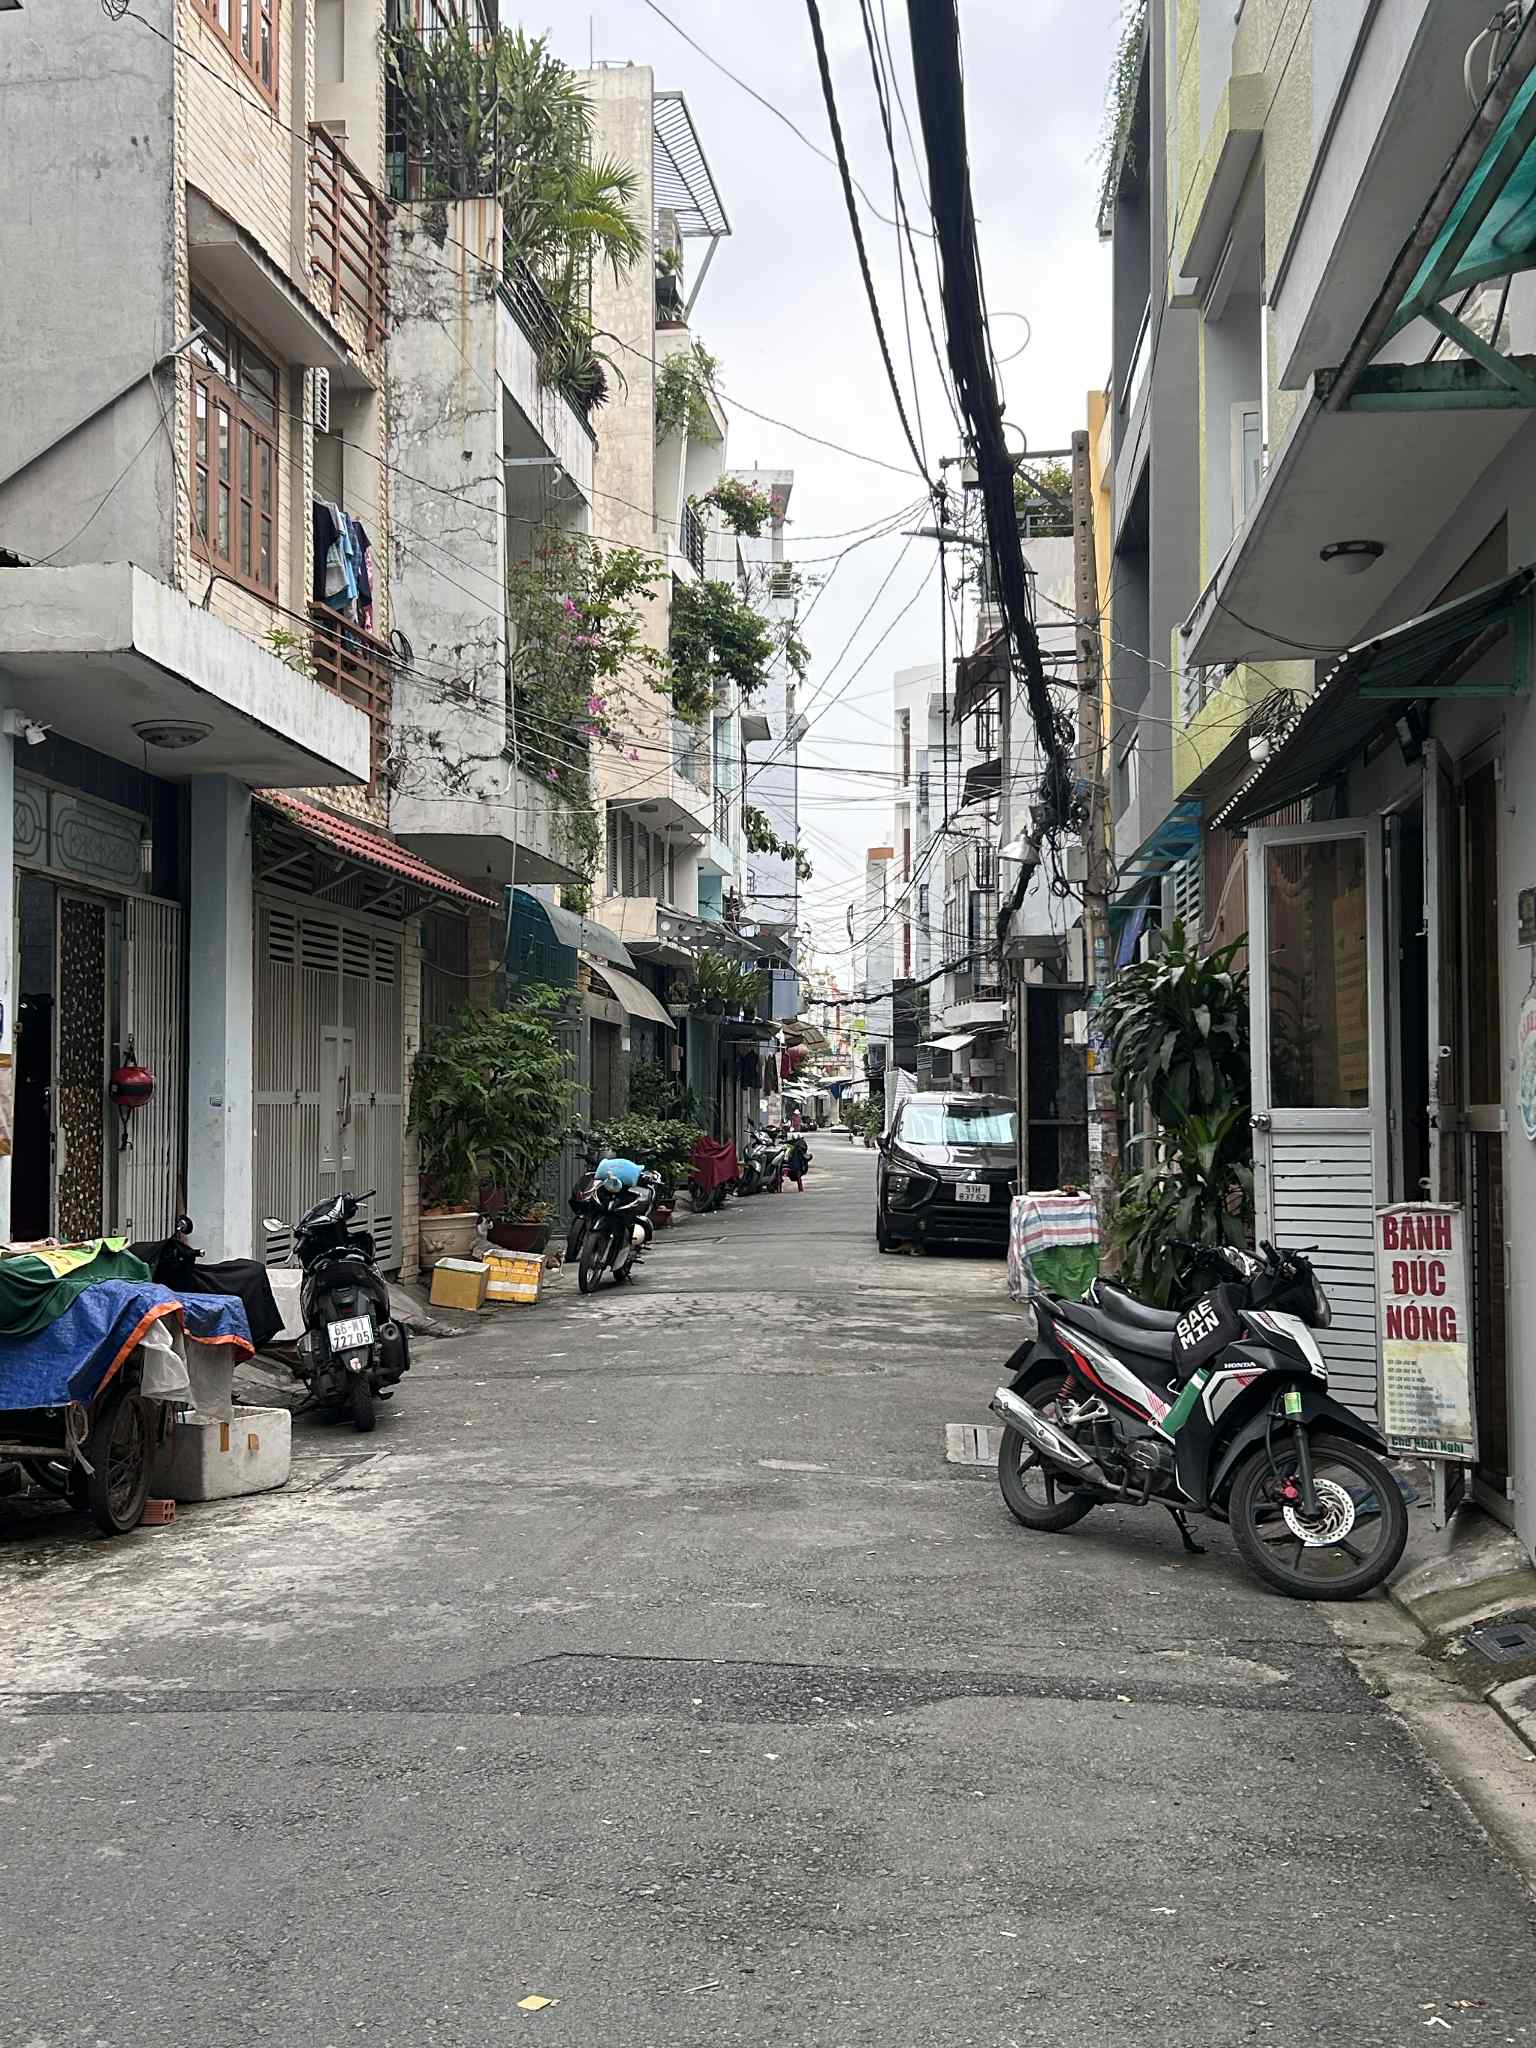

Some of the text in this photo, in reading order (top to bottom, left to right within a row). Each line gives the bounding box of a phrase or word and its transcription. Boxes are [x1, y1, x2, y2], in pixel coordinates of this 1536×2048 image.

[1383, 1212, 1452, 1250] BÁNH
[1392, 1255, 1447, 1297] ĐÚC
[1176, 1299, 1212, 1337] BAE
[1180, 1310, 1220, 1350] MIN
[1386, 1300, 1458, 1343] NÓNG
[1224, 1361, 1256, 1369] HONDA
